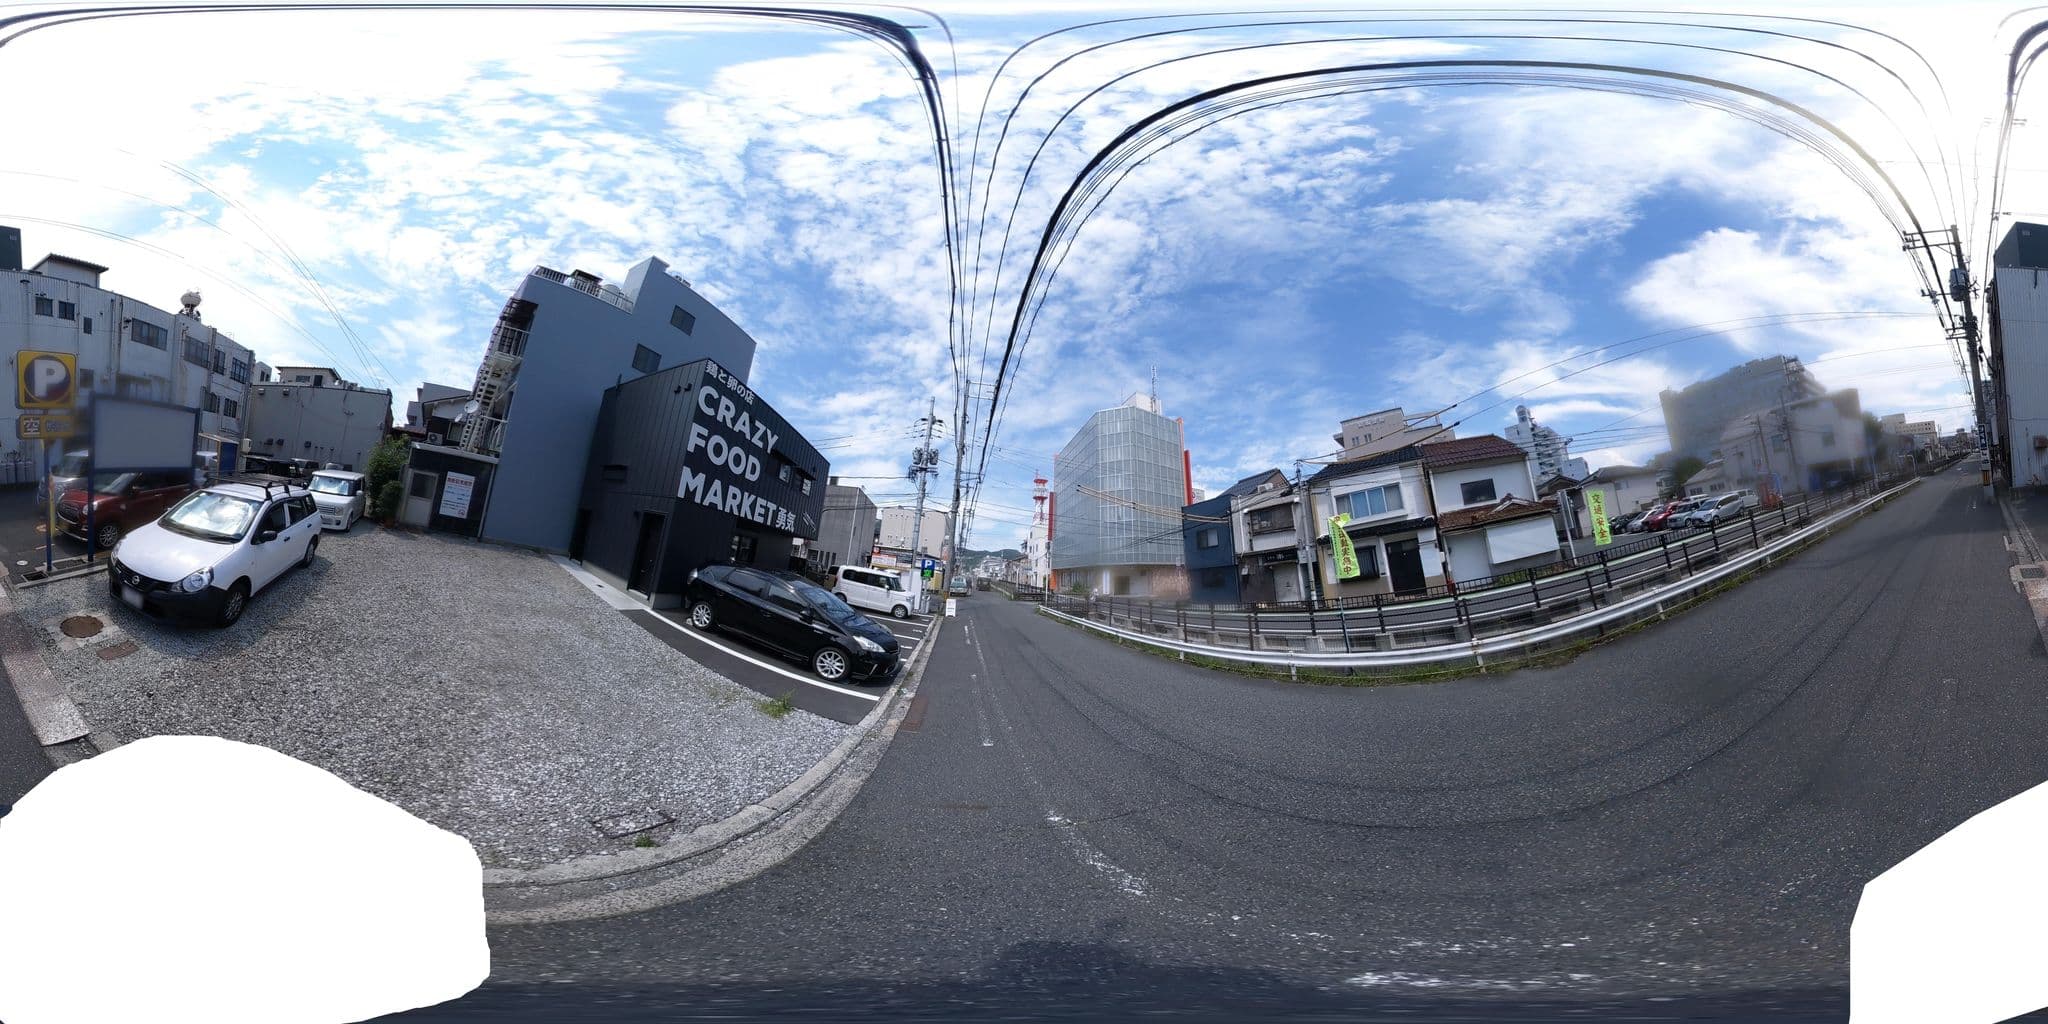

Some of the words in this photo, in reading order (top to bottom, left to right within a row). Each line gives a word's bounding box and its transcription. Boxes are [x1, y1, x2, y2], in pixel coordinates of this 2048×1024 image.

[34, 360, 66, 397] P
[705, 359, 755, 406] 鶏と卵の店
[698, 385, 779, 455] CRAZY
[686, 422, 761, 482] FOOD
[677, 465, 778, 527] MARKET
[775, 507, 797, 533] 勇気
[1591, 494, 1608, 540] 交通安全
[924, 560, 933, 568] P
